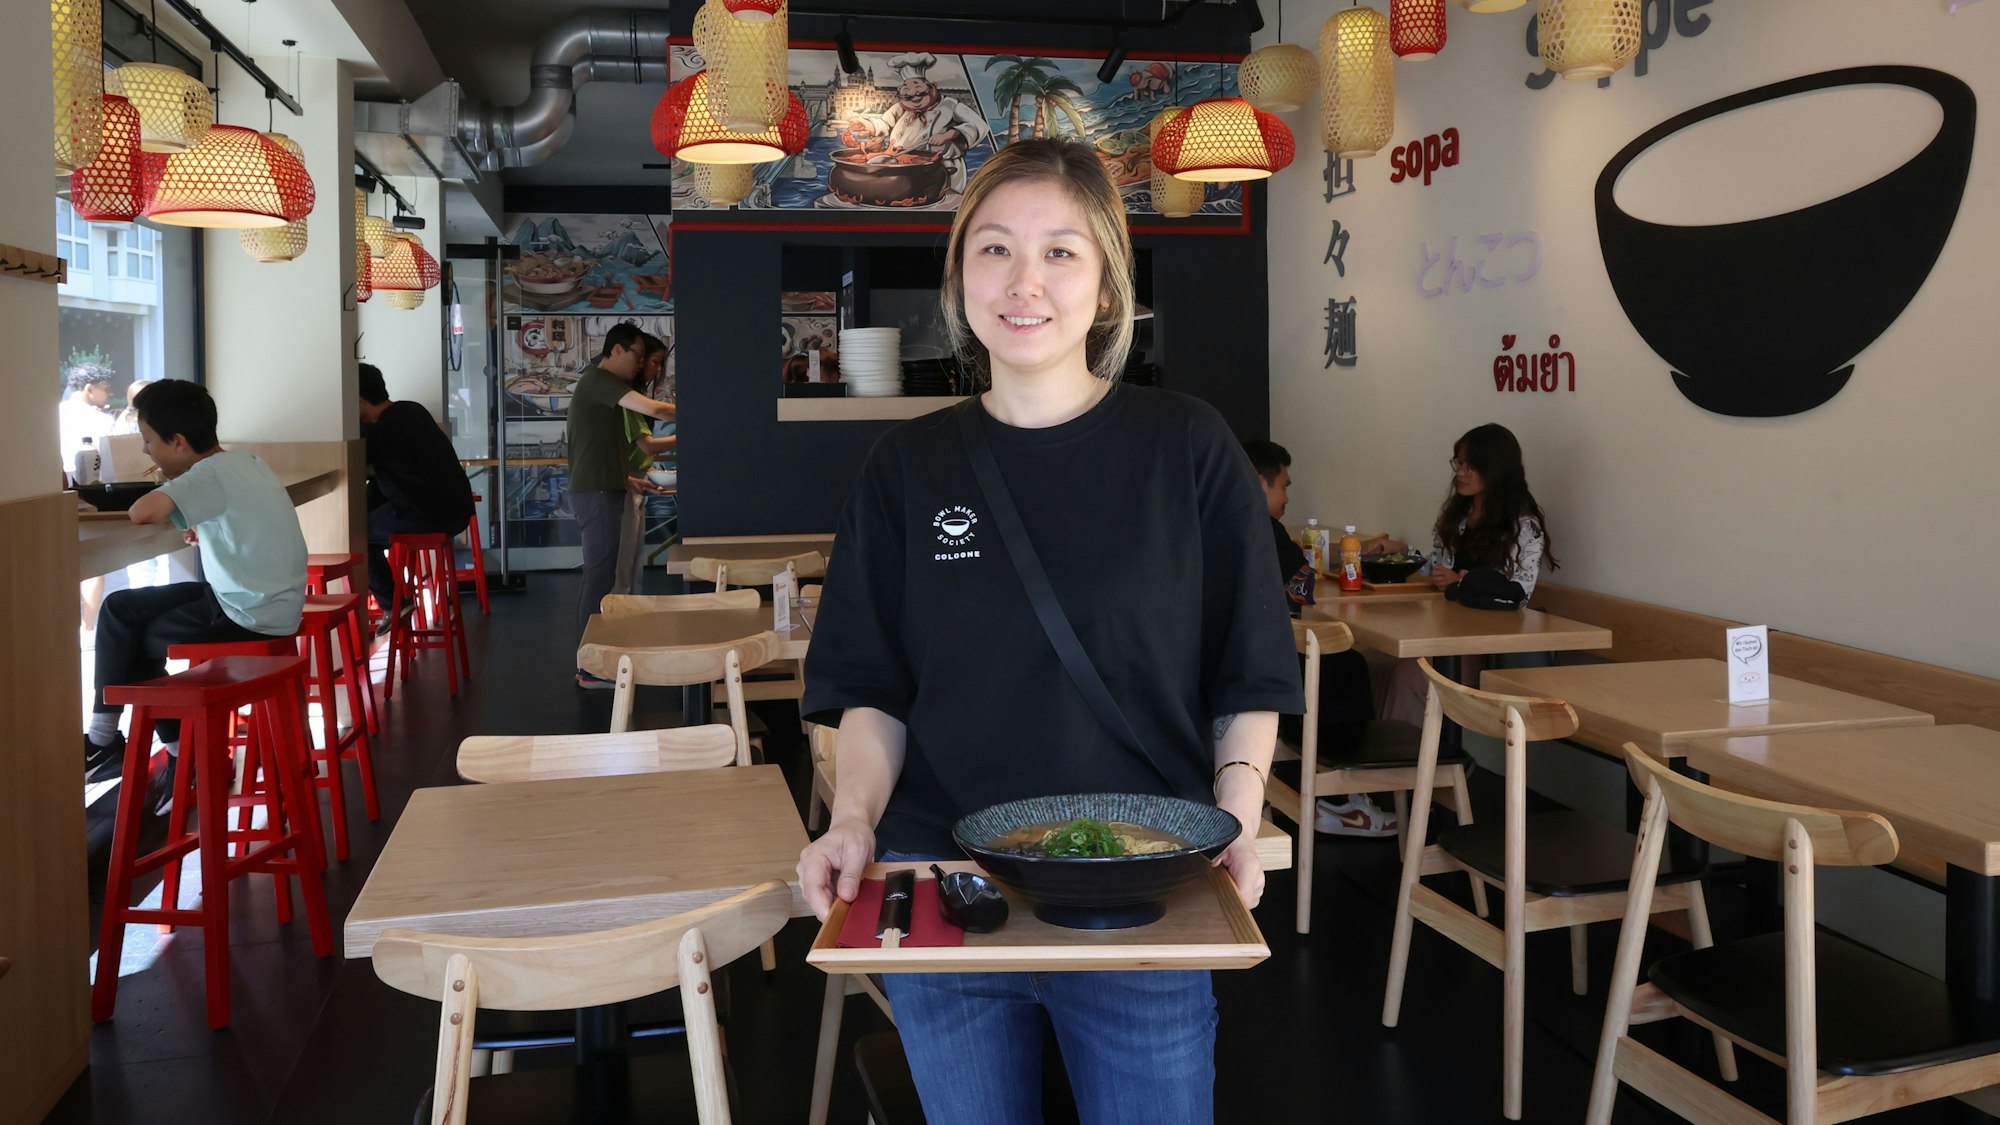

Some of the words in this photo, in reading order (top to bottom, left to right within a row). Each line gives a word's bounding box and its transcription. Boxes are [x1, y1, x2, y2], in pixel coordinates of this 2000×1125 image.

[1390, 127, 1460, 186] sopa
[1417, 230, 1544, 298] とんこつ
[1493, 334, 1576, 393] ต้มยำ
[933, 508, 951, 527] BOWL
[954, 506, 978, 524] MAKER
[937, 532, 975, 546] SOCIETY
